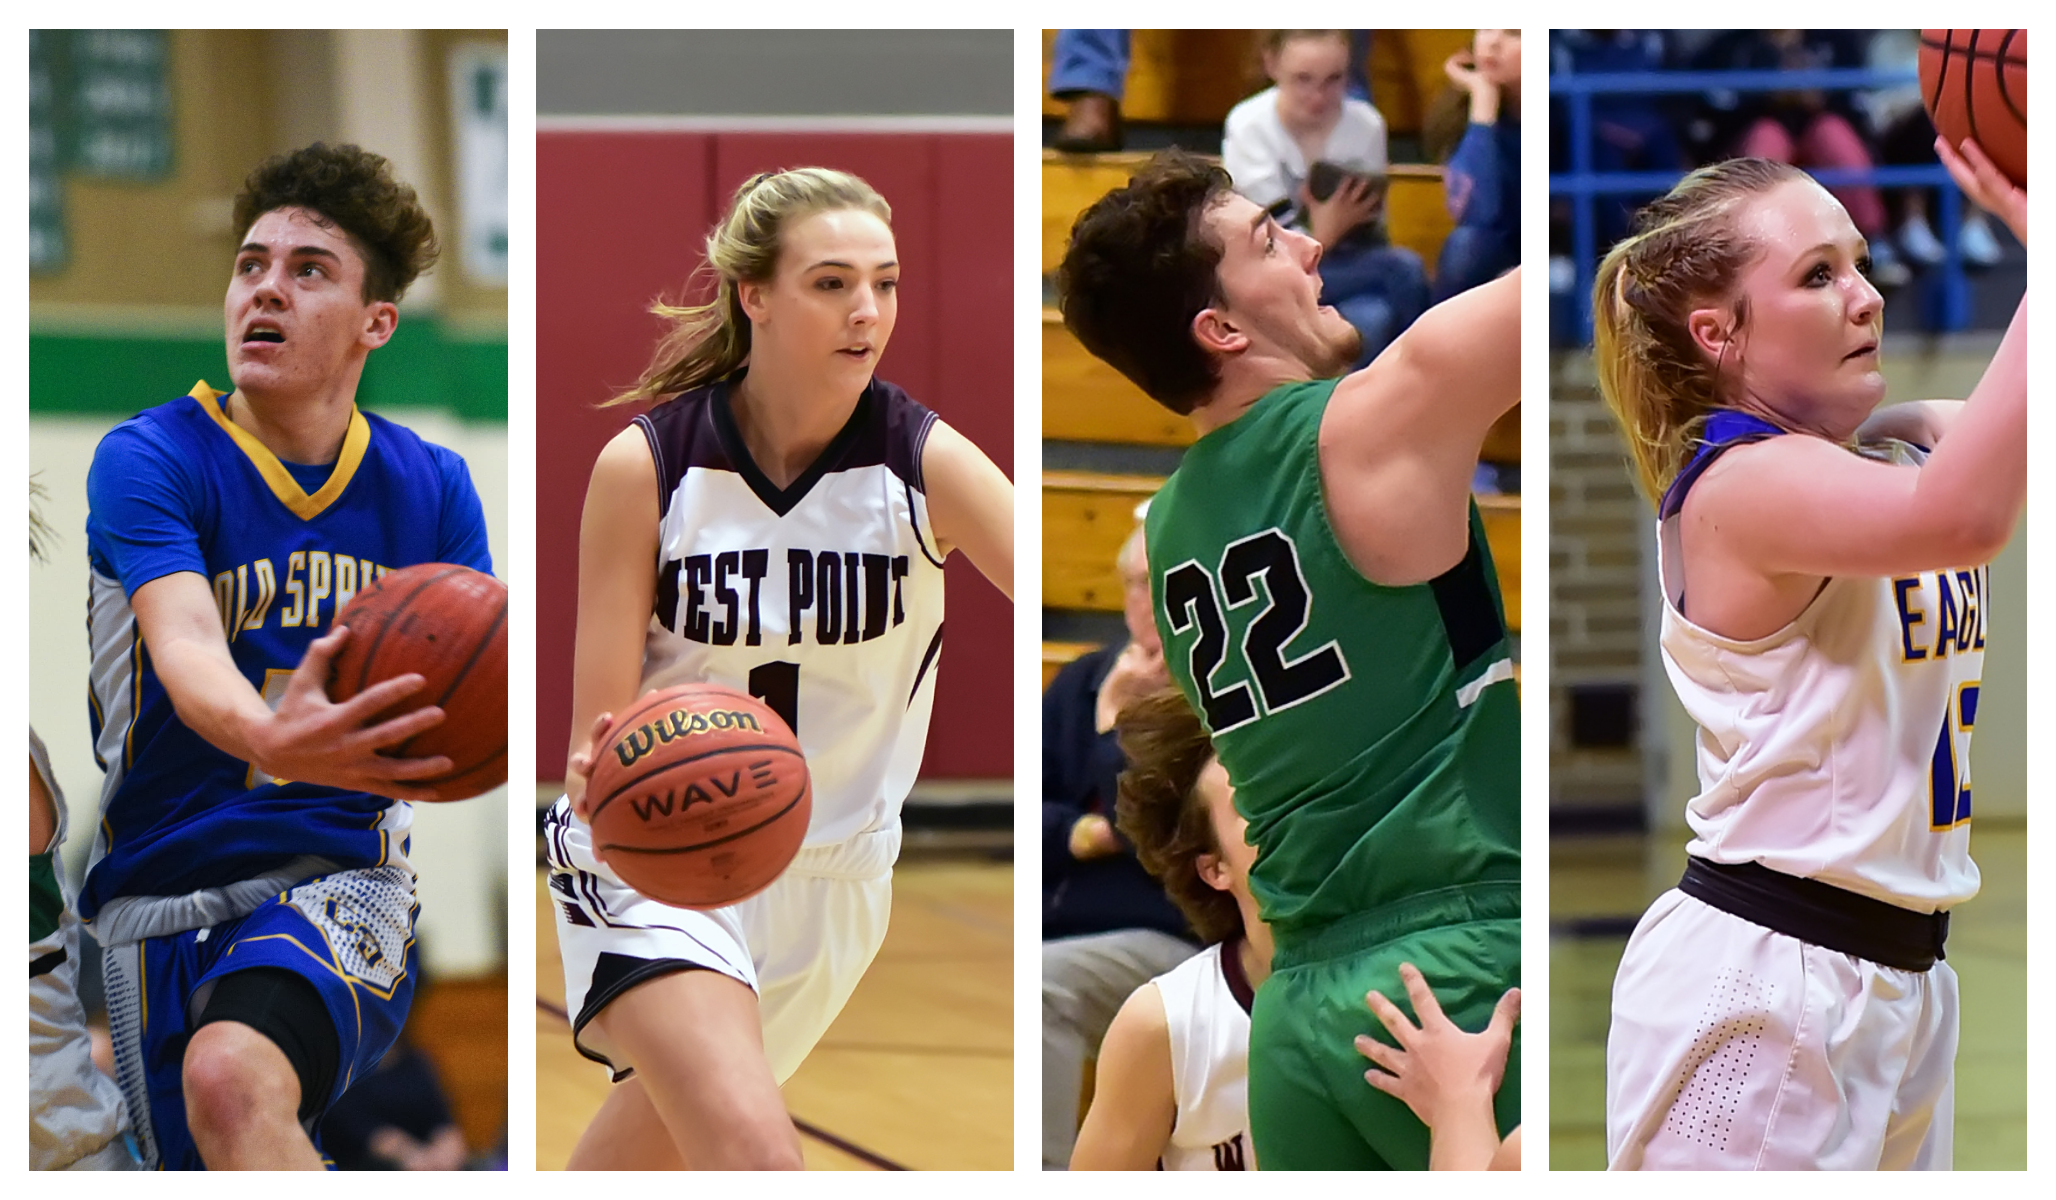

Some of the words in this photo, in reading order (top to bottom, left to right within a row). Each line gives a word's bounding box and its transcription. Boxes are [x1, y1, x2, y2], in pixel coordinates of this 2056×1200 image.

[281, 551, 397, 632] SPR
[787, 548, 909, 647] POINT
[1163, 526, 1353, 739] 22
[1891, 564, 1989, 665] EAGL
[613, 708, 764, 768] Wilson
[630, 760, 778, 822] WAVE
